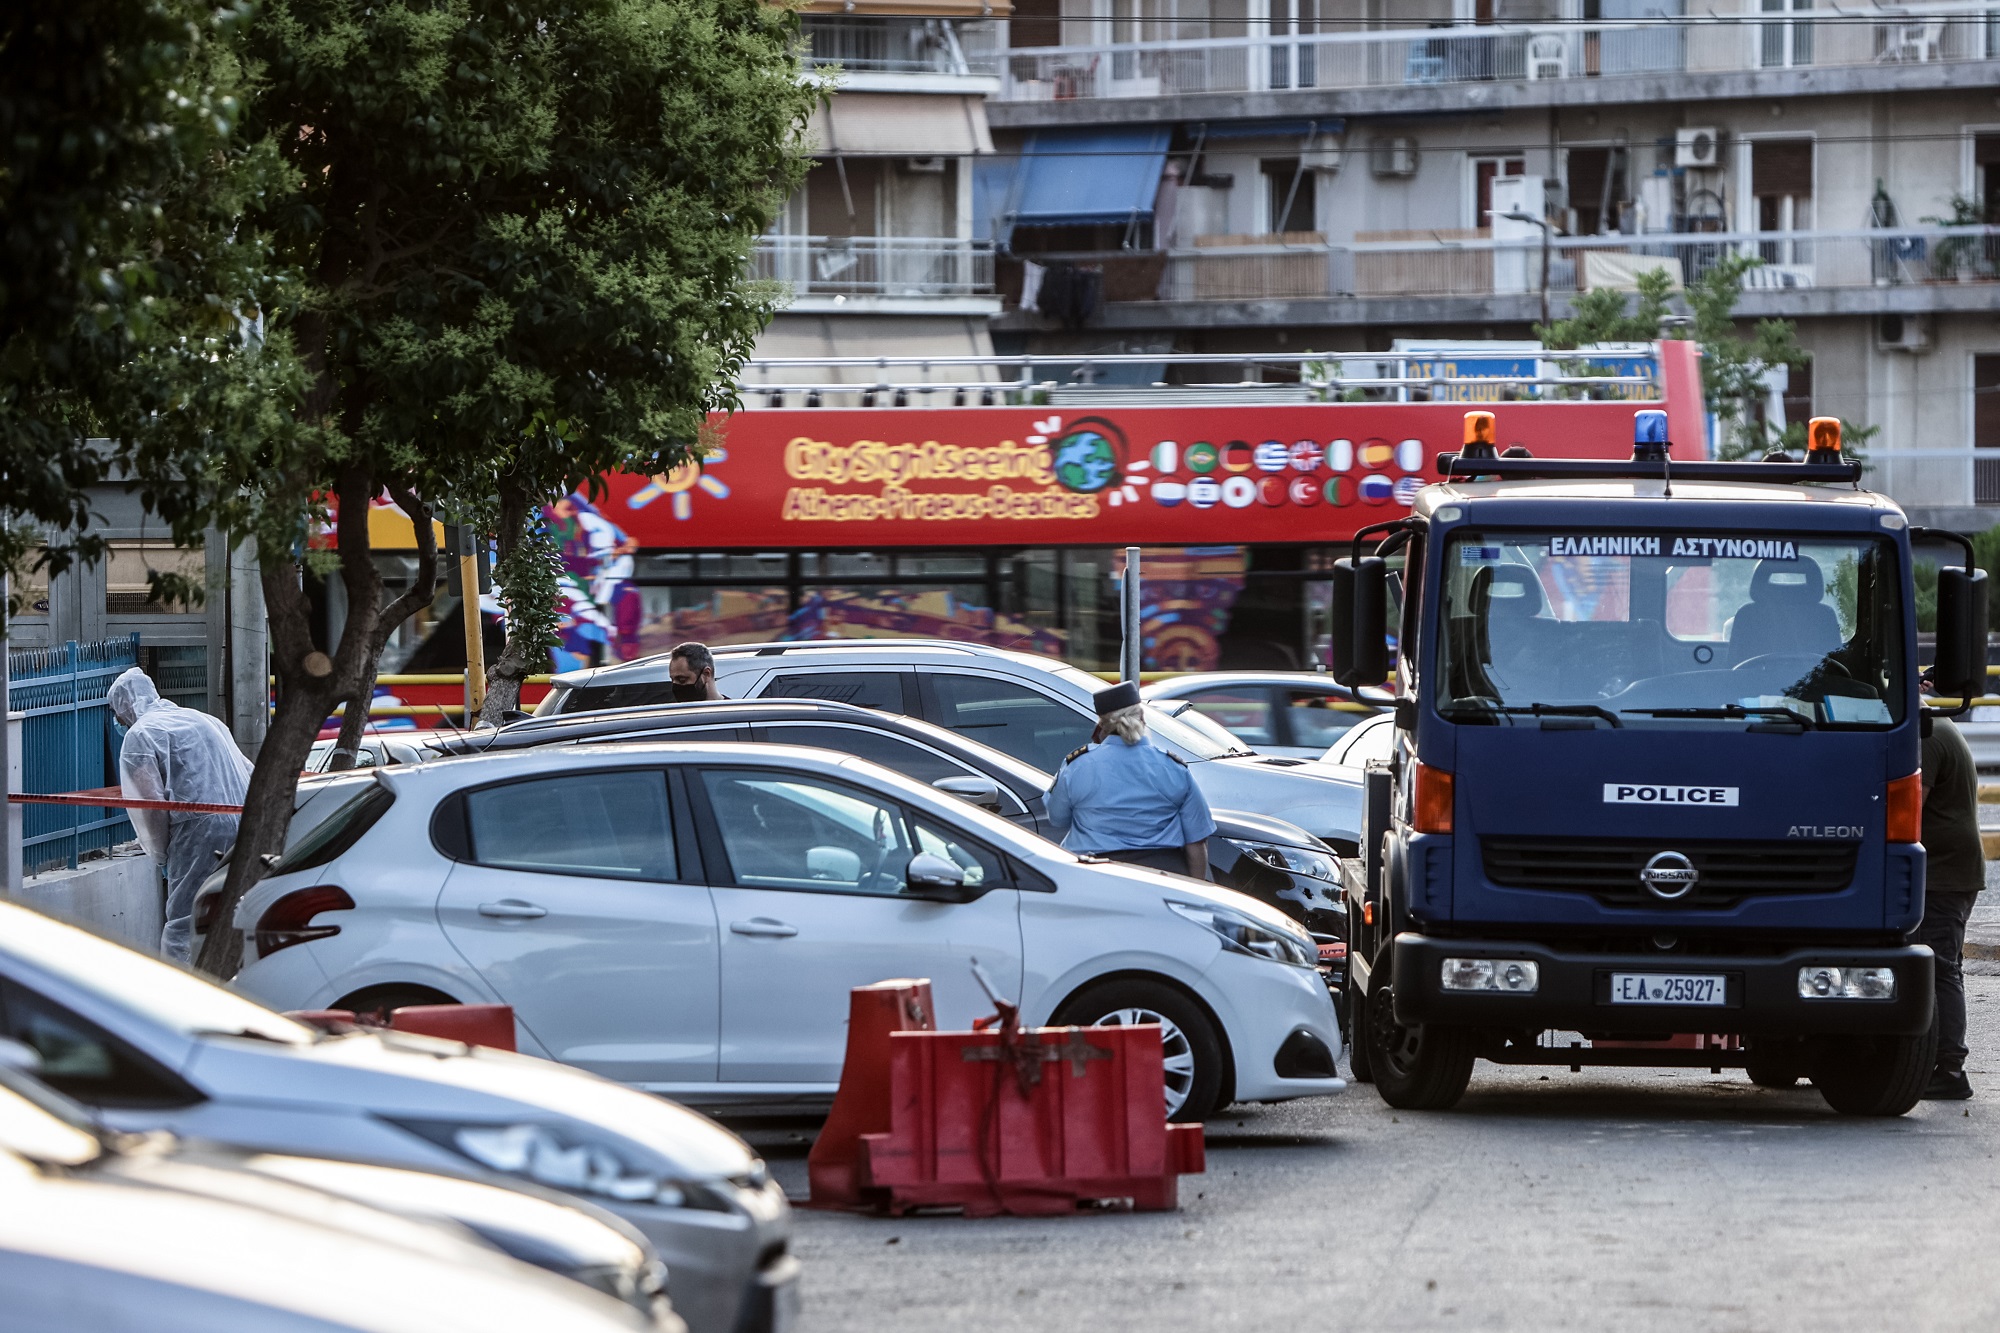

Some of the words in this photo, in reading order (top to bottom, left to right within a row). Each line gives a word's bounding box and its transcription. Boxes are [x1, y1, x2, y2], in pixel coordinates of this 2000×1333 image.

[1551, 536, 1661, 556] ΕΛΛΗΝΙΚΗ
[1672, 538, 1797, 560] ΑΣΤΥΝΟΜΙΑ
[1617, 786, 1727, 804] POLICE
[1787, 825, 1865, 838] ATLEON
[1647, 871, 1694, 881] NISSAN
[1664, 978, 1715, 1002] 25927
